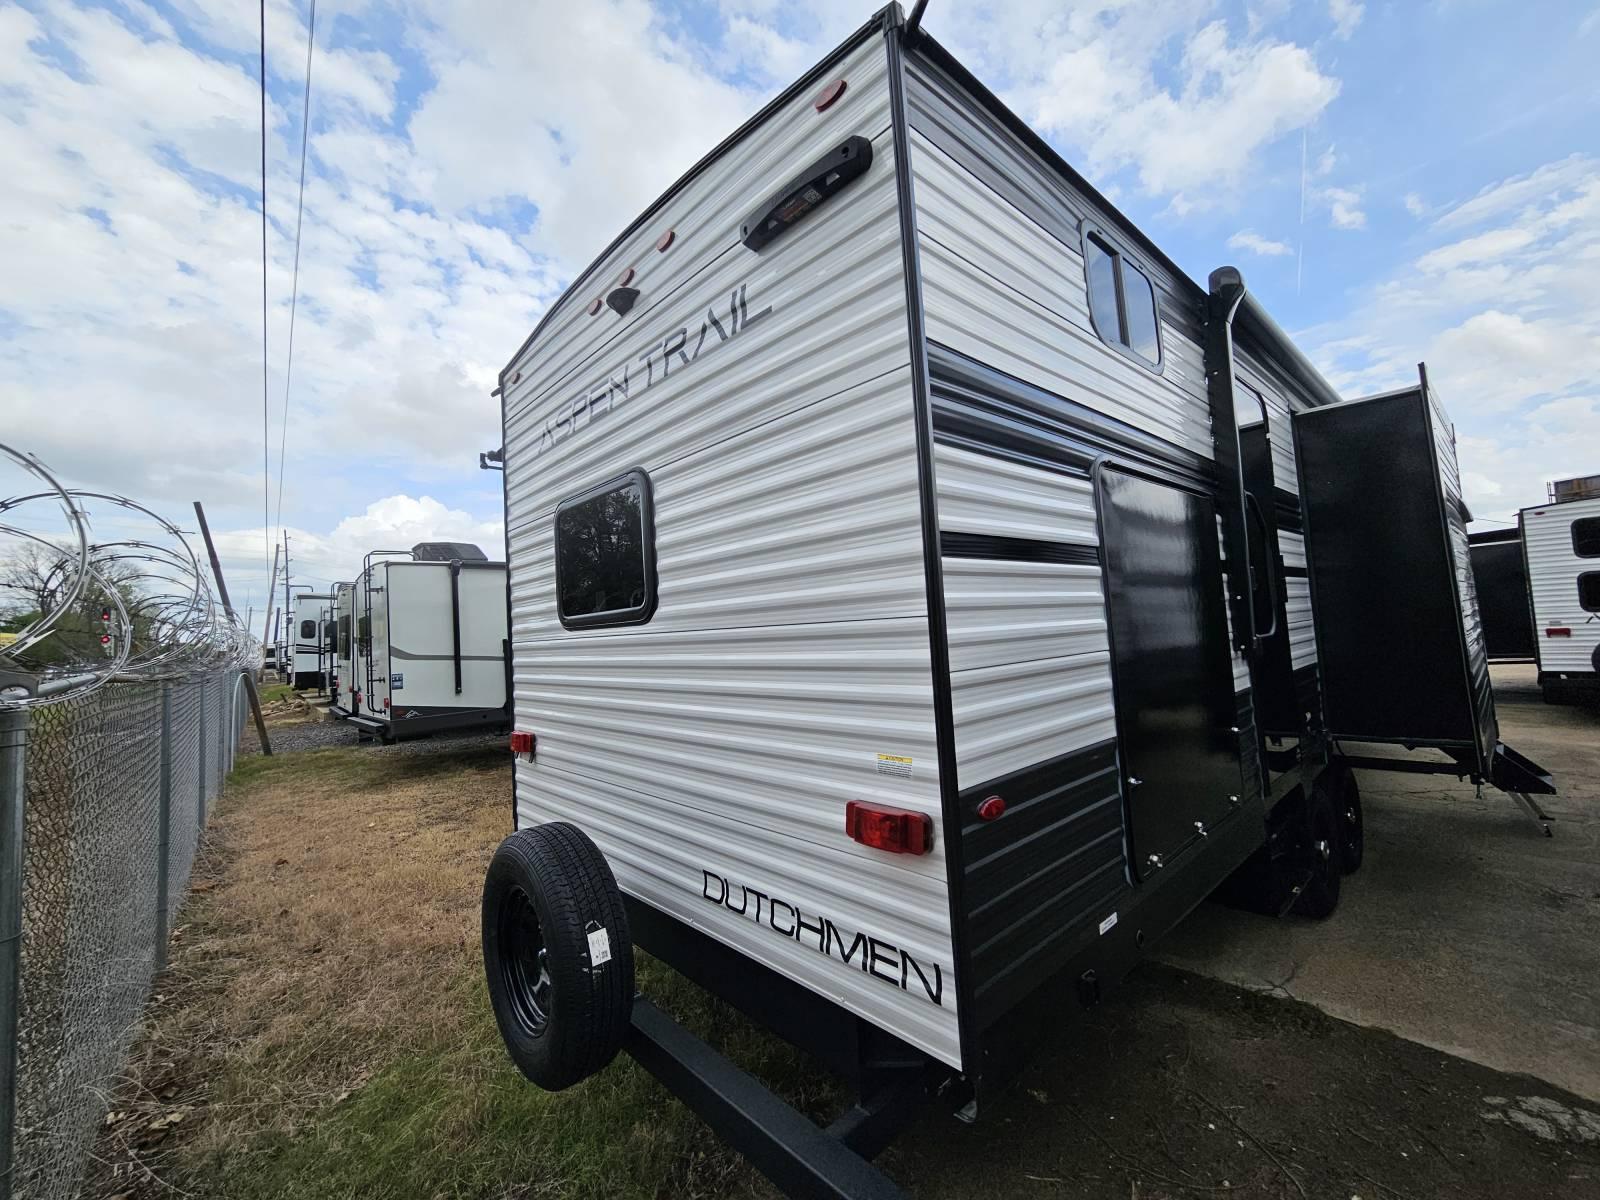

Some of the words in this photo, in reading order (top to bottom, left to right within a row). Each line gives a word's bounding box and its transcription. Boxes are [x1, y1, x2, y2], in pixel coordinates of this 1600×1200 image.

[537, 364, 630, 454] ASPEN
[639, 284, 773, 388] TRAIL
[702, 869, 943, 1006] DUTCHMEN
